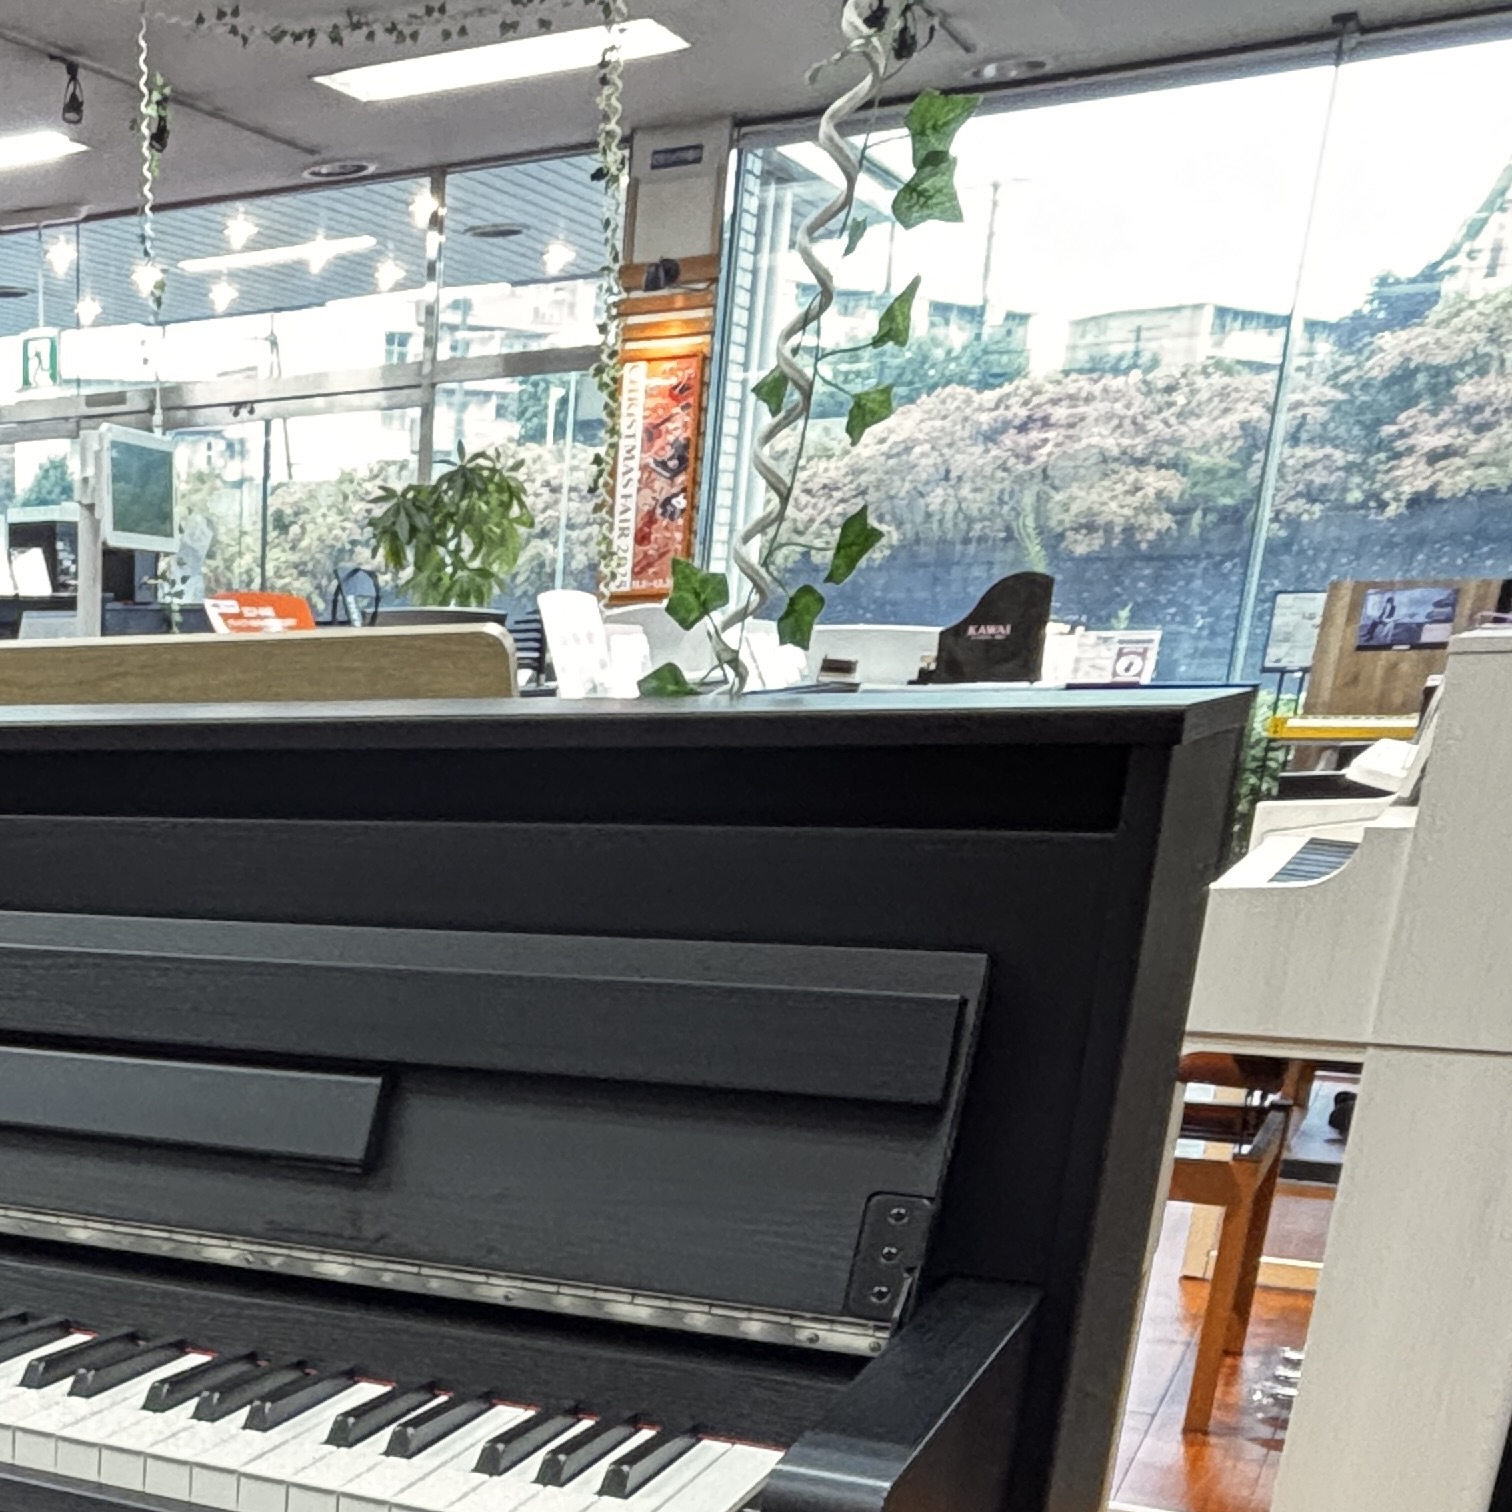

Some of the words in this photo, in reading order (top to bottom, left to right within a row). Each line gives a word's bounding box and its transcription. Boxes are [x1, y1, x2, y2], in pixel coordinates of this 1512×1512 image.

[621, 364, 641, 489] CHRISTMAS
[617, 494, 635, 539] FAIR
[968, 624, 1012, 636] KAWAI
